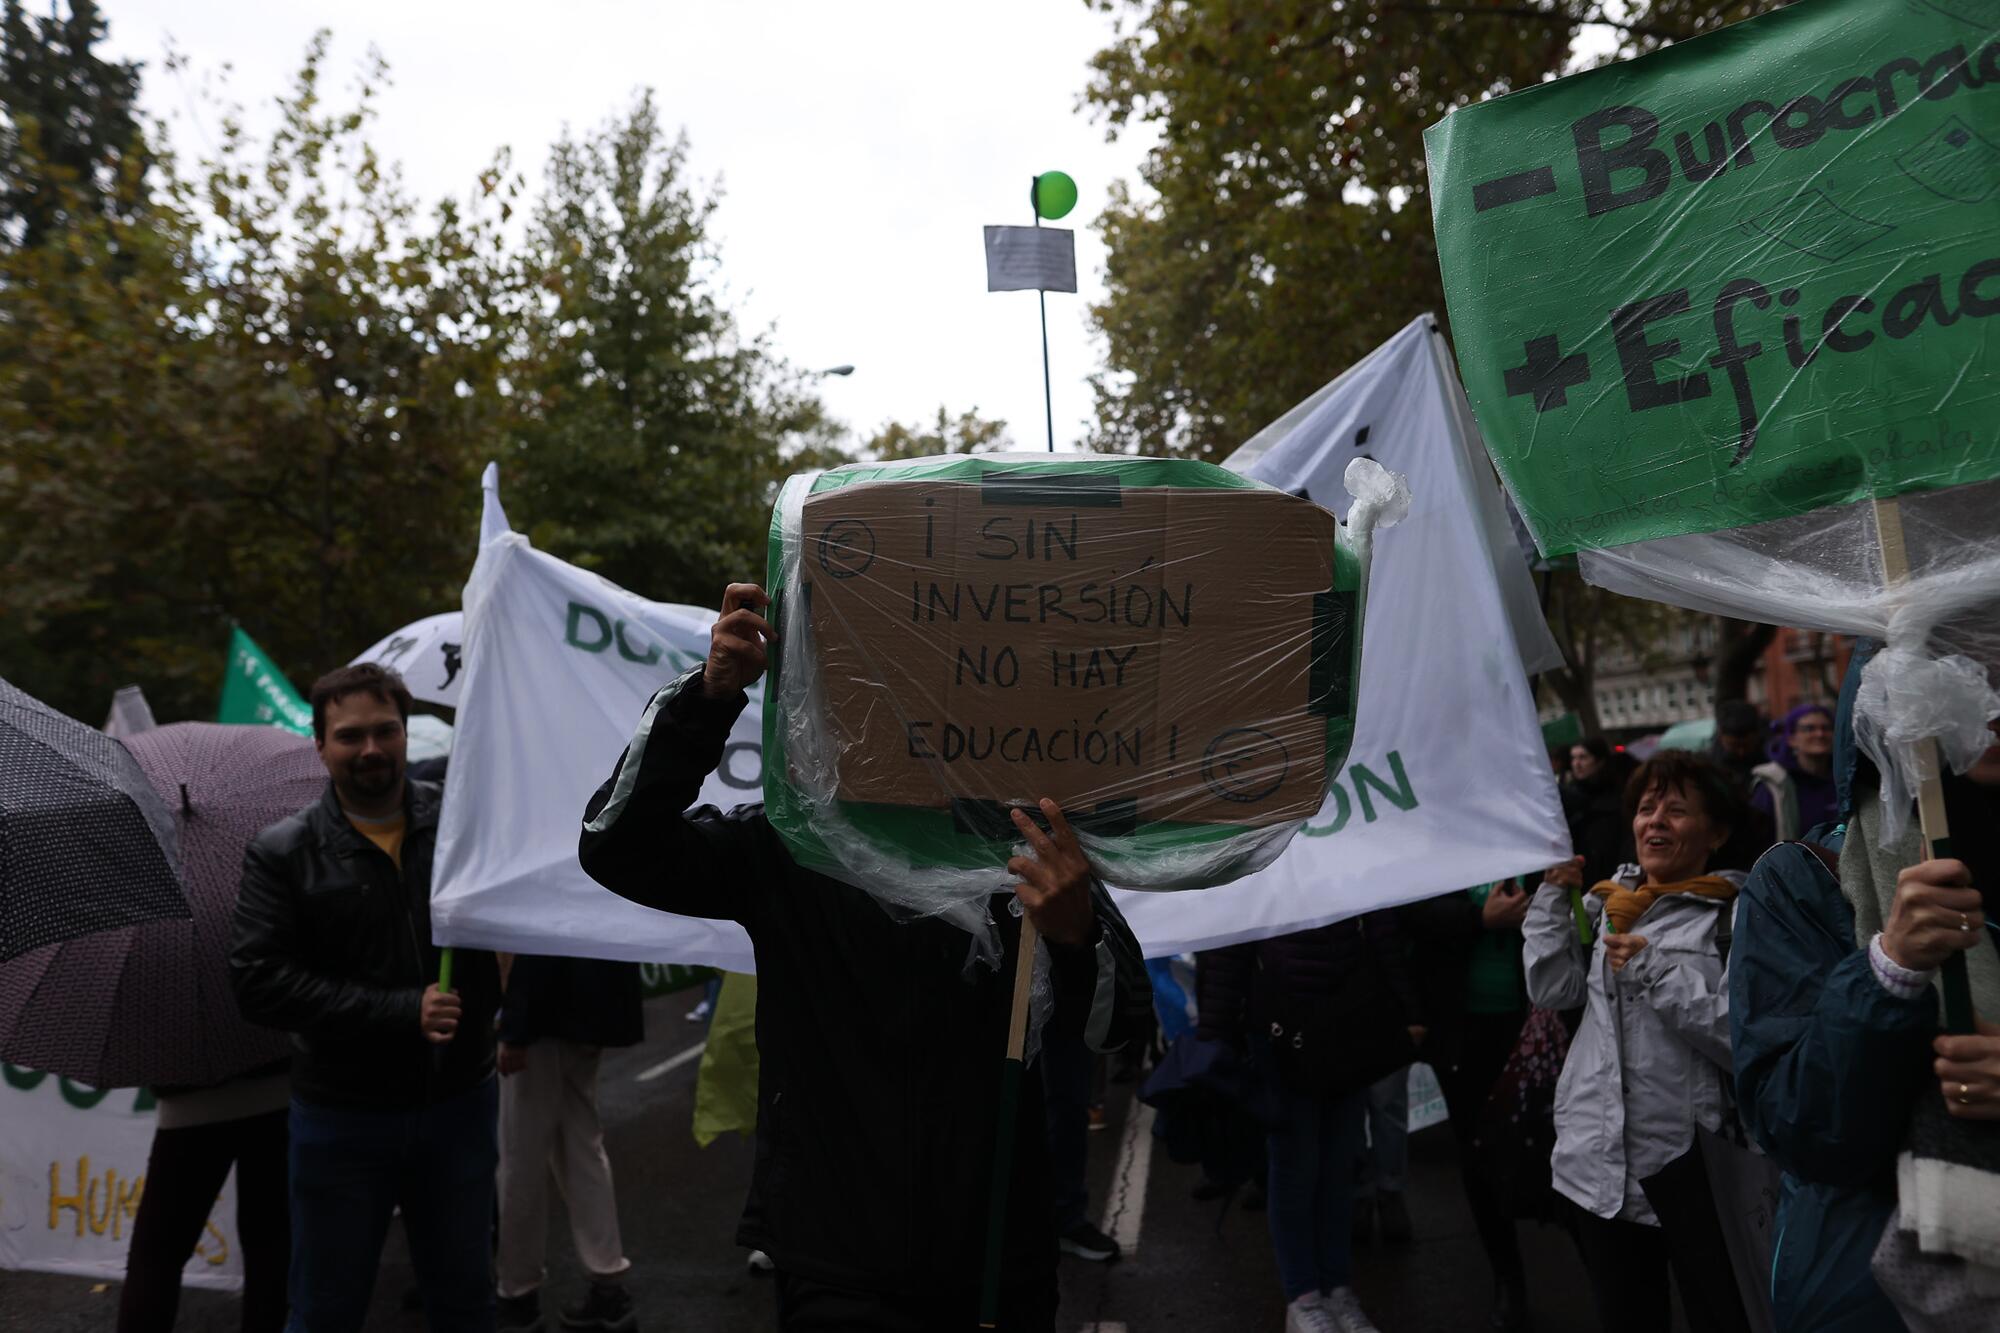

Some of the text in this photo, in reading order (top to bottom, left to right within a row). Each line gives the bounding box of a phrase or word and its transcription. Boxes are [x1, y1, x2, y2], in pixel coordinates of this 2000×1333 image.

[976, 513, 1078, 561] SIN
[911, 555, 1194, 629] INVERSIÓN
[955, 645, 1139, 690] NO HAY
[906, 708, 1142, 767] EDUCACIÓN
